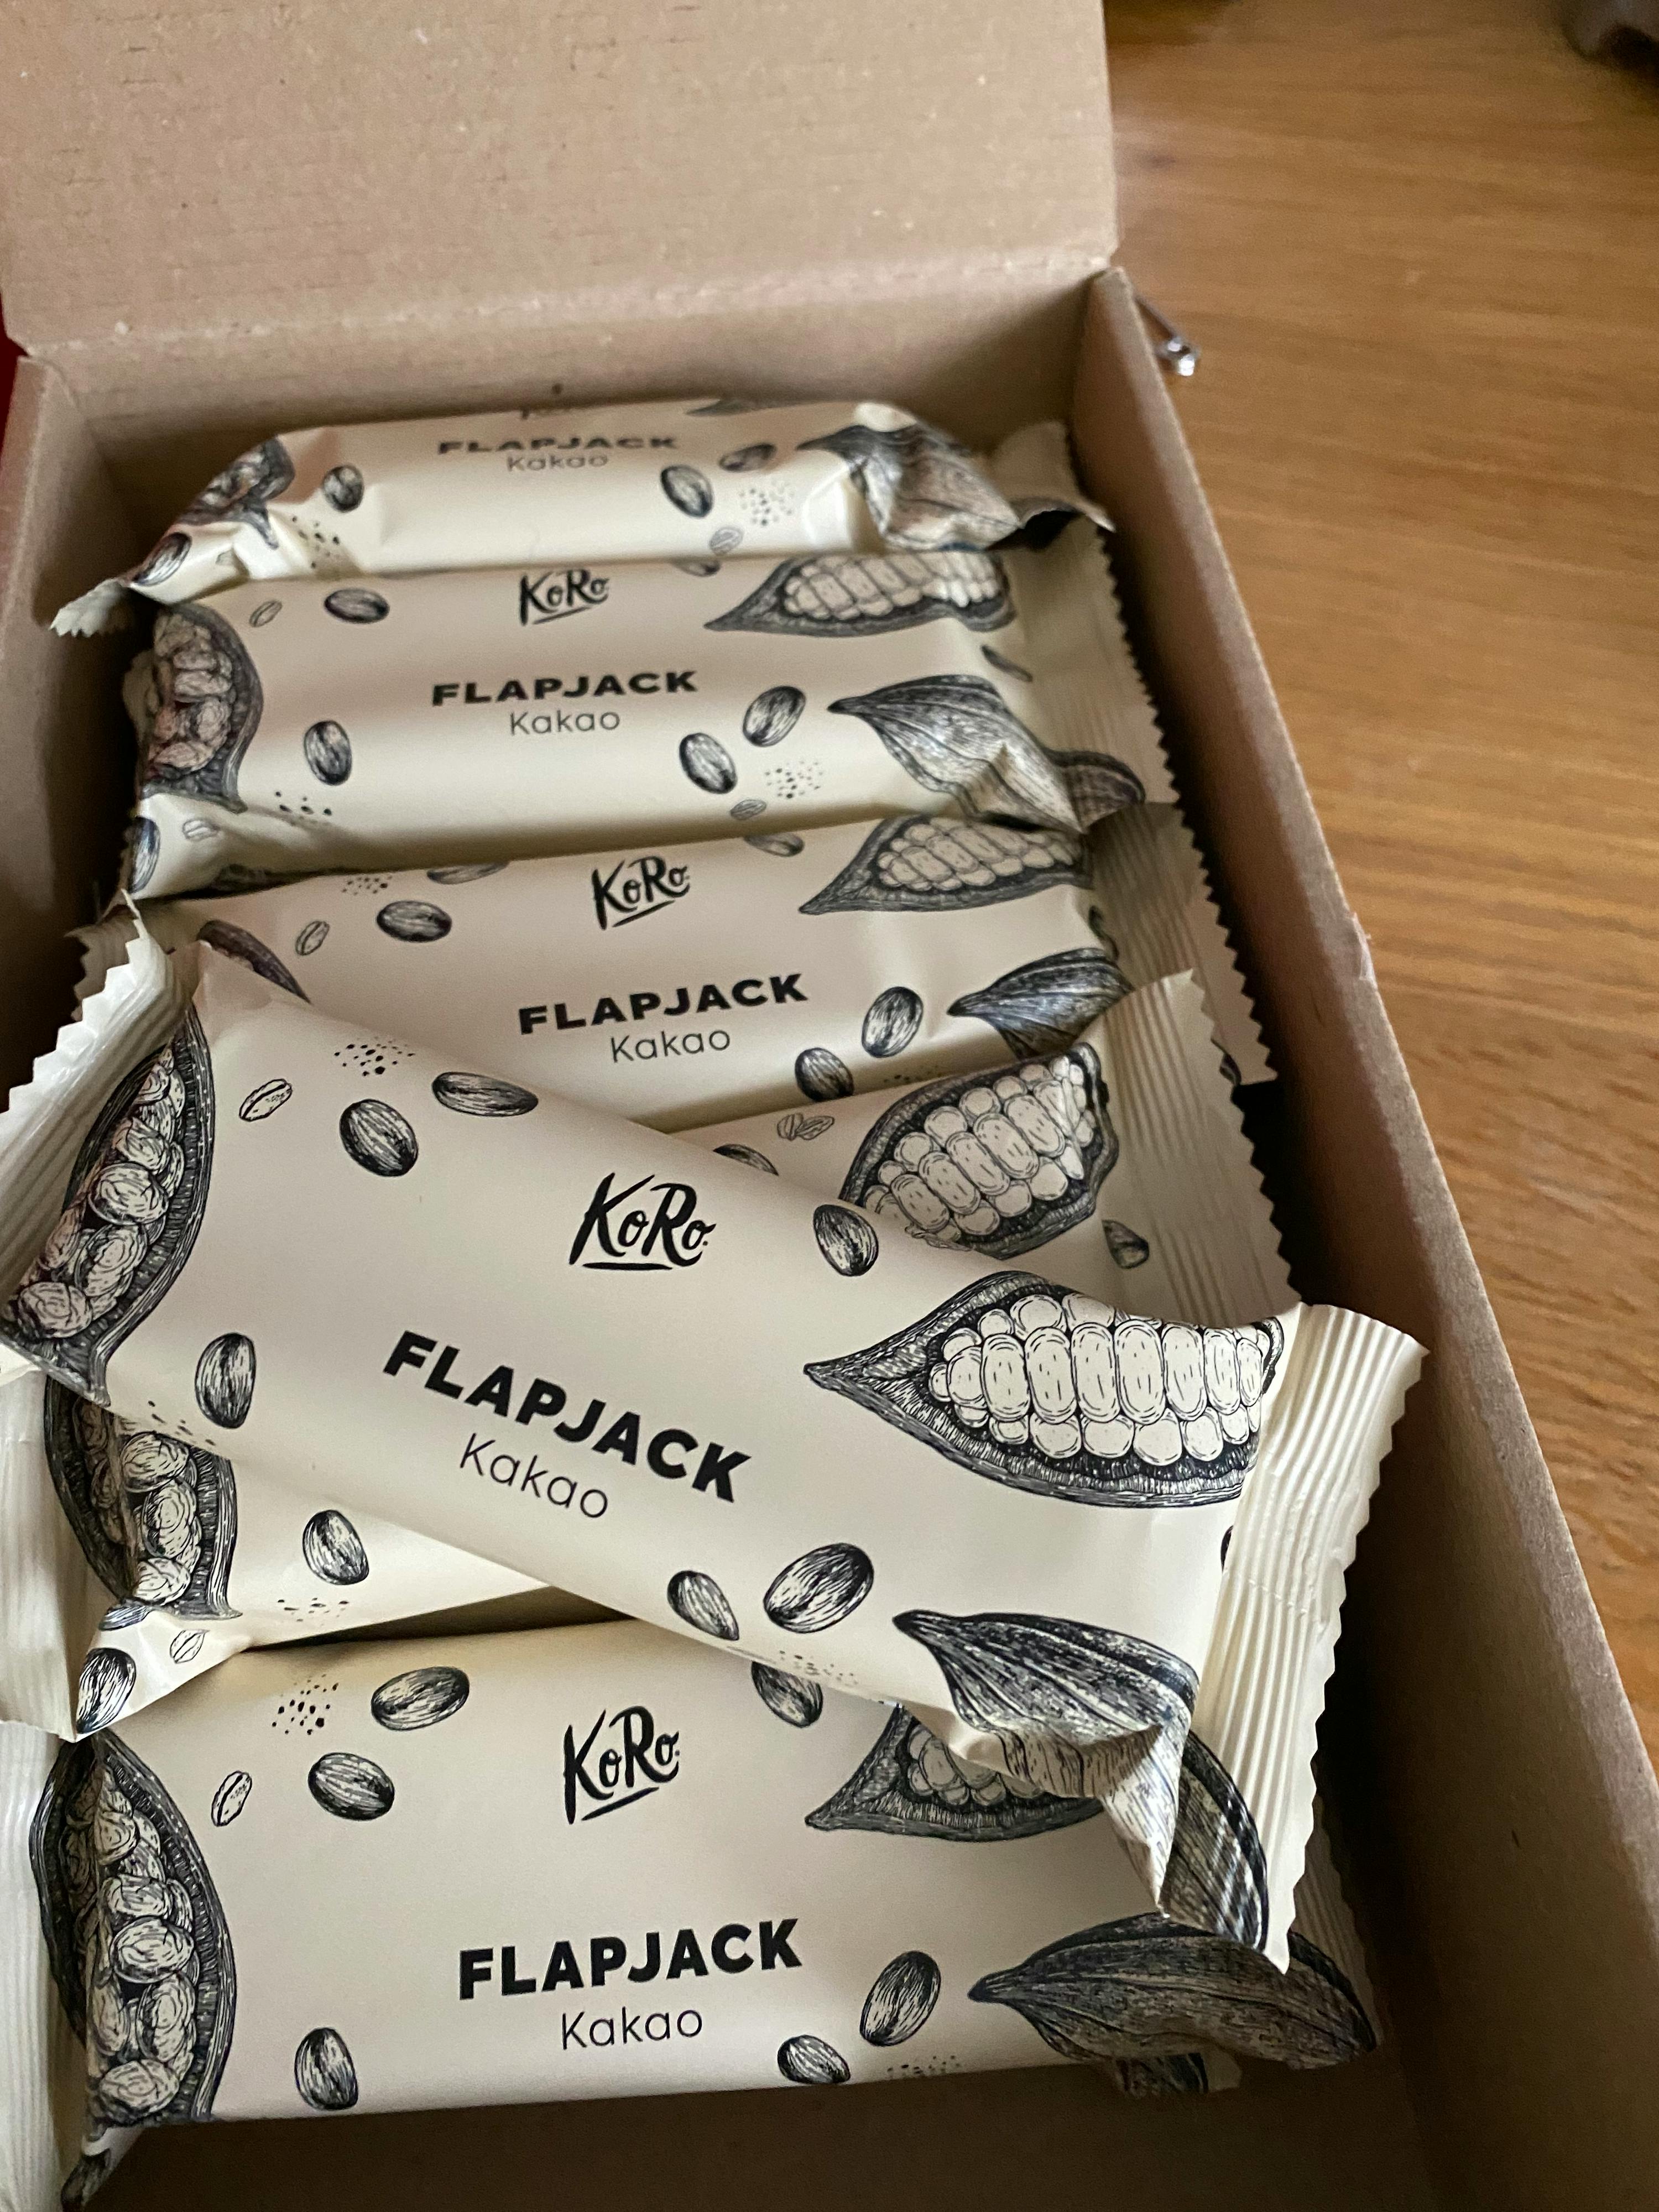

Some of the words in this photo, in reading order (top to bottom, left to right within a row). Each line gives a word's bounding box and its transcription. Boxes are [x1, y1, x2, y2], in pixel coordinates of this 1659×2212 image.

[437, 436, 679, 455] FLAPJACK
[507, 454, 609, 472] Kakao
[519, 568, 609, 626] KoRo
[432, 670, 698, 707] FLAPJACK
[509, 710, 620, 735] Kakao
[591, 855, 691, 930] KoRo
[518, 973, 808, 1035] FLAPJACK
[611, 1029, 731, 1063] Kakao
[568, 1172, 717, 1271] KoRo
[383, 1329, 752, 1503] FLAPJACK
[459, 1432, 608, 1519] Kakao
[563, 1705, 680, 1825] KoRo
[459, 1918, 803, 2001] FLAPJACK
[561, 2006, 703, 2050] Kakao
